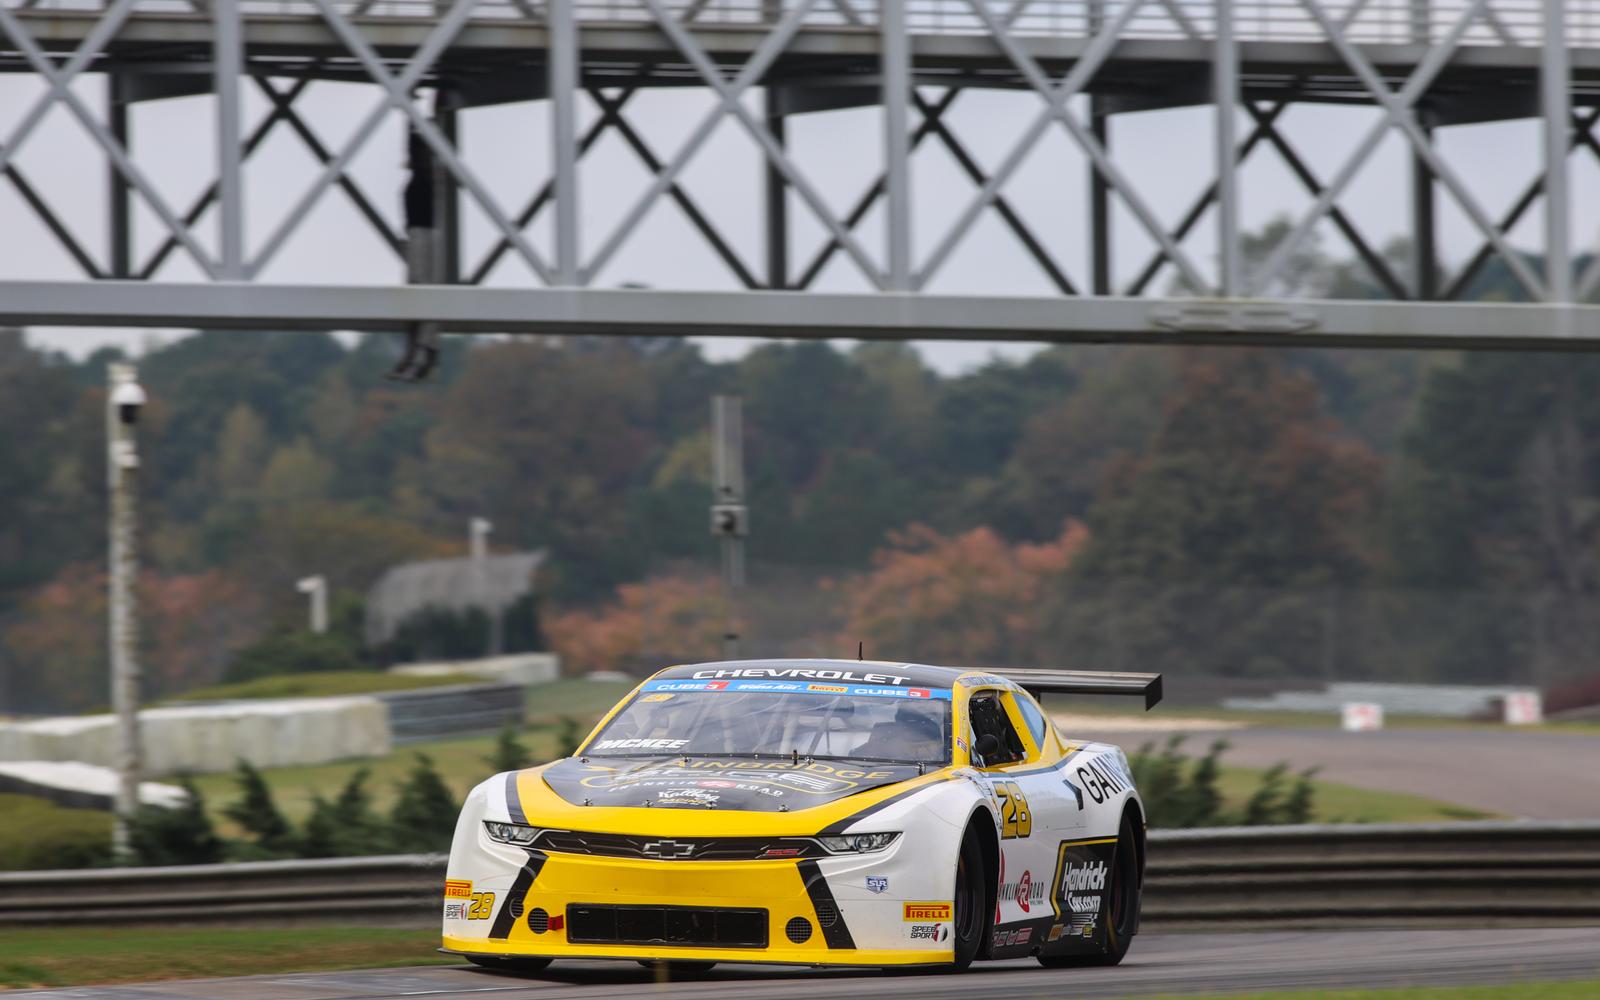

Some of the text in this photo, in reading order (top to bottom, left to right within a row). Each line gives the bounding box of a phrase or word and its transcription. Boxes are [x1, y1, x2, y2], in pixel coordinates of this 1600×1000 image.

[693, 669, 911, 685] CHEVROLET
[992, 781, 1032, 840] 28
[1062, 861, 1108, 900] Hendrick
[468, 892, 496, 920] 28
[906, 904, 950, 918] PIRELLI
